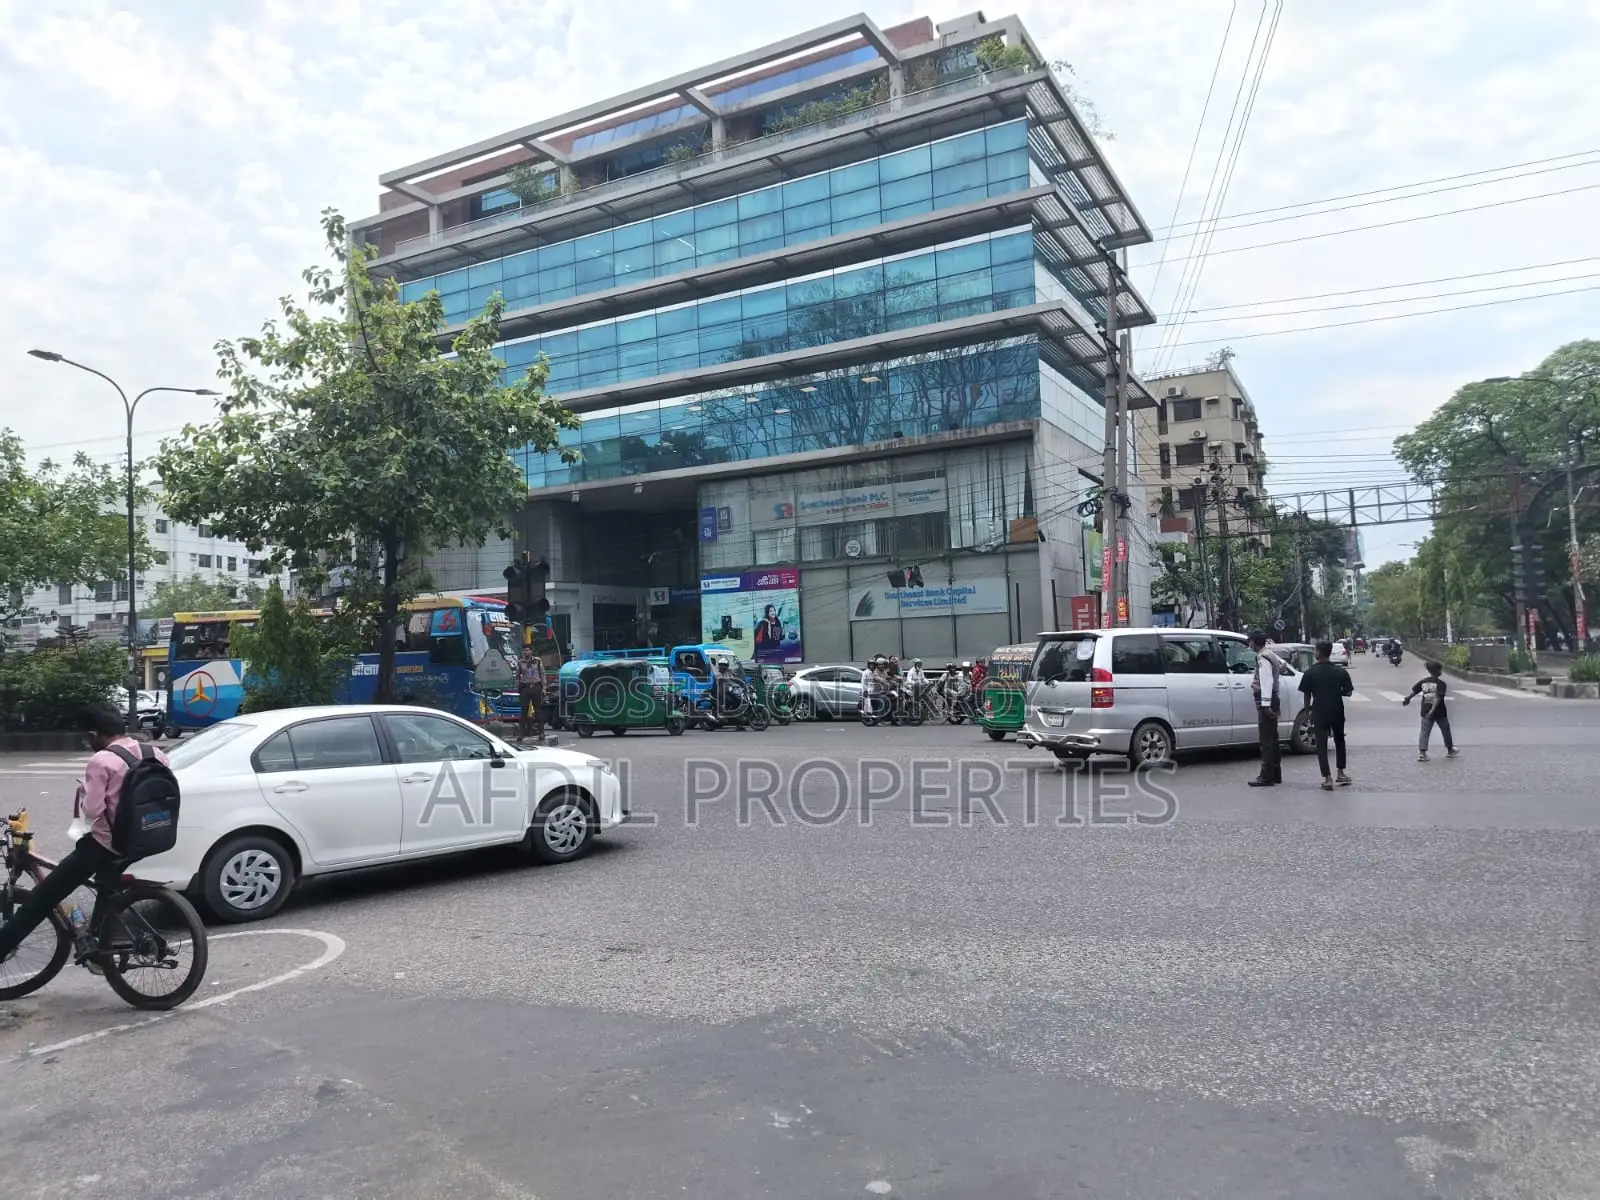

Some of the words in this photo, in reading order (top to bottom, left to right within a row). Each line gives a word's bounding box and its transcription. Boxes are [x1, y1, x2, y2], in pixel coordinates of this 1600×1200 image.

[885, 591, 924, 600] Southeast
[925, 588, 946, 597] Bank
[946, 586, 976, 597] Capital
[900, 598, 932, 608] Services
[934, 596, 968, 606] Limited
[1182, 718, 1219, 726] NOAH
